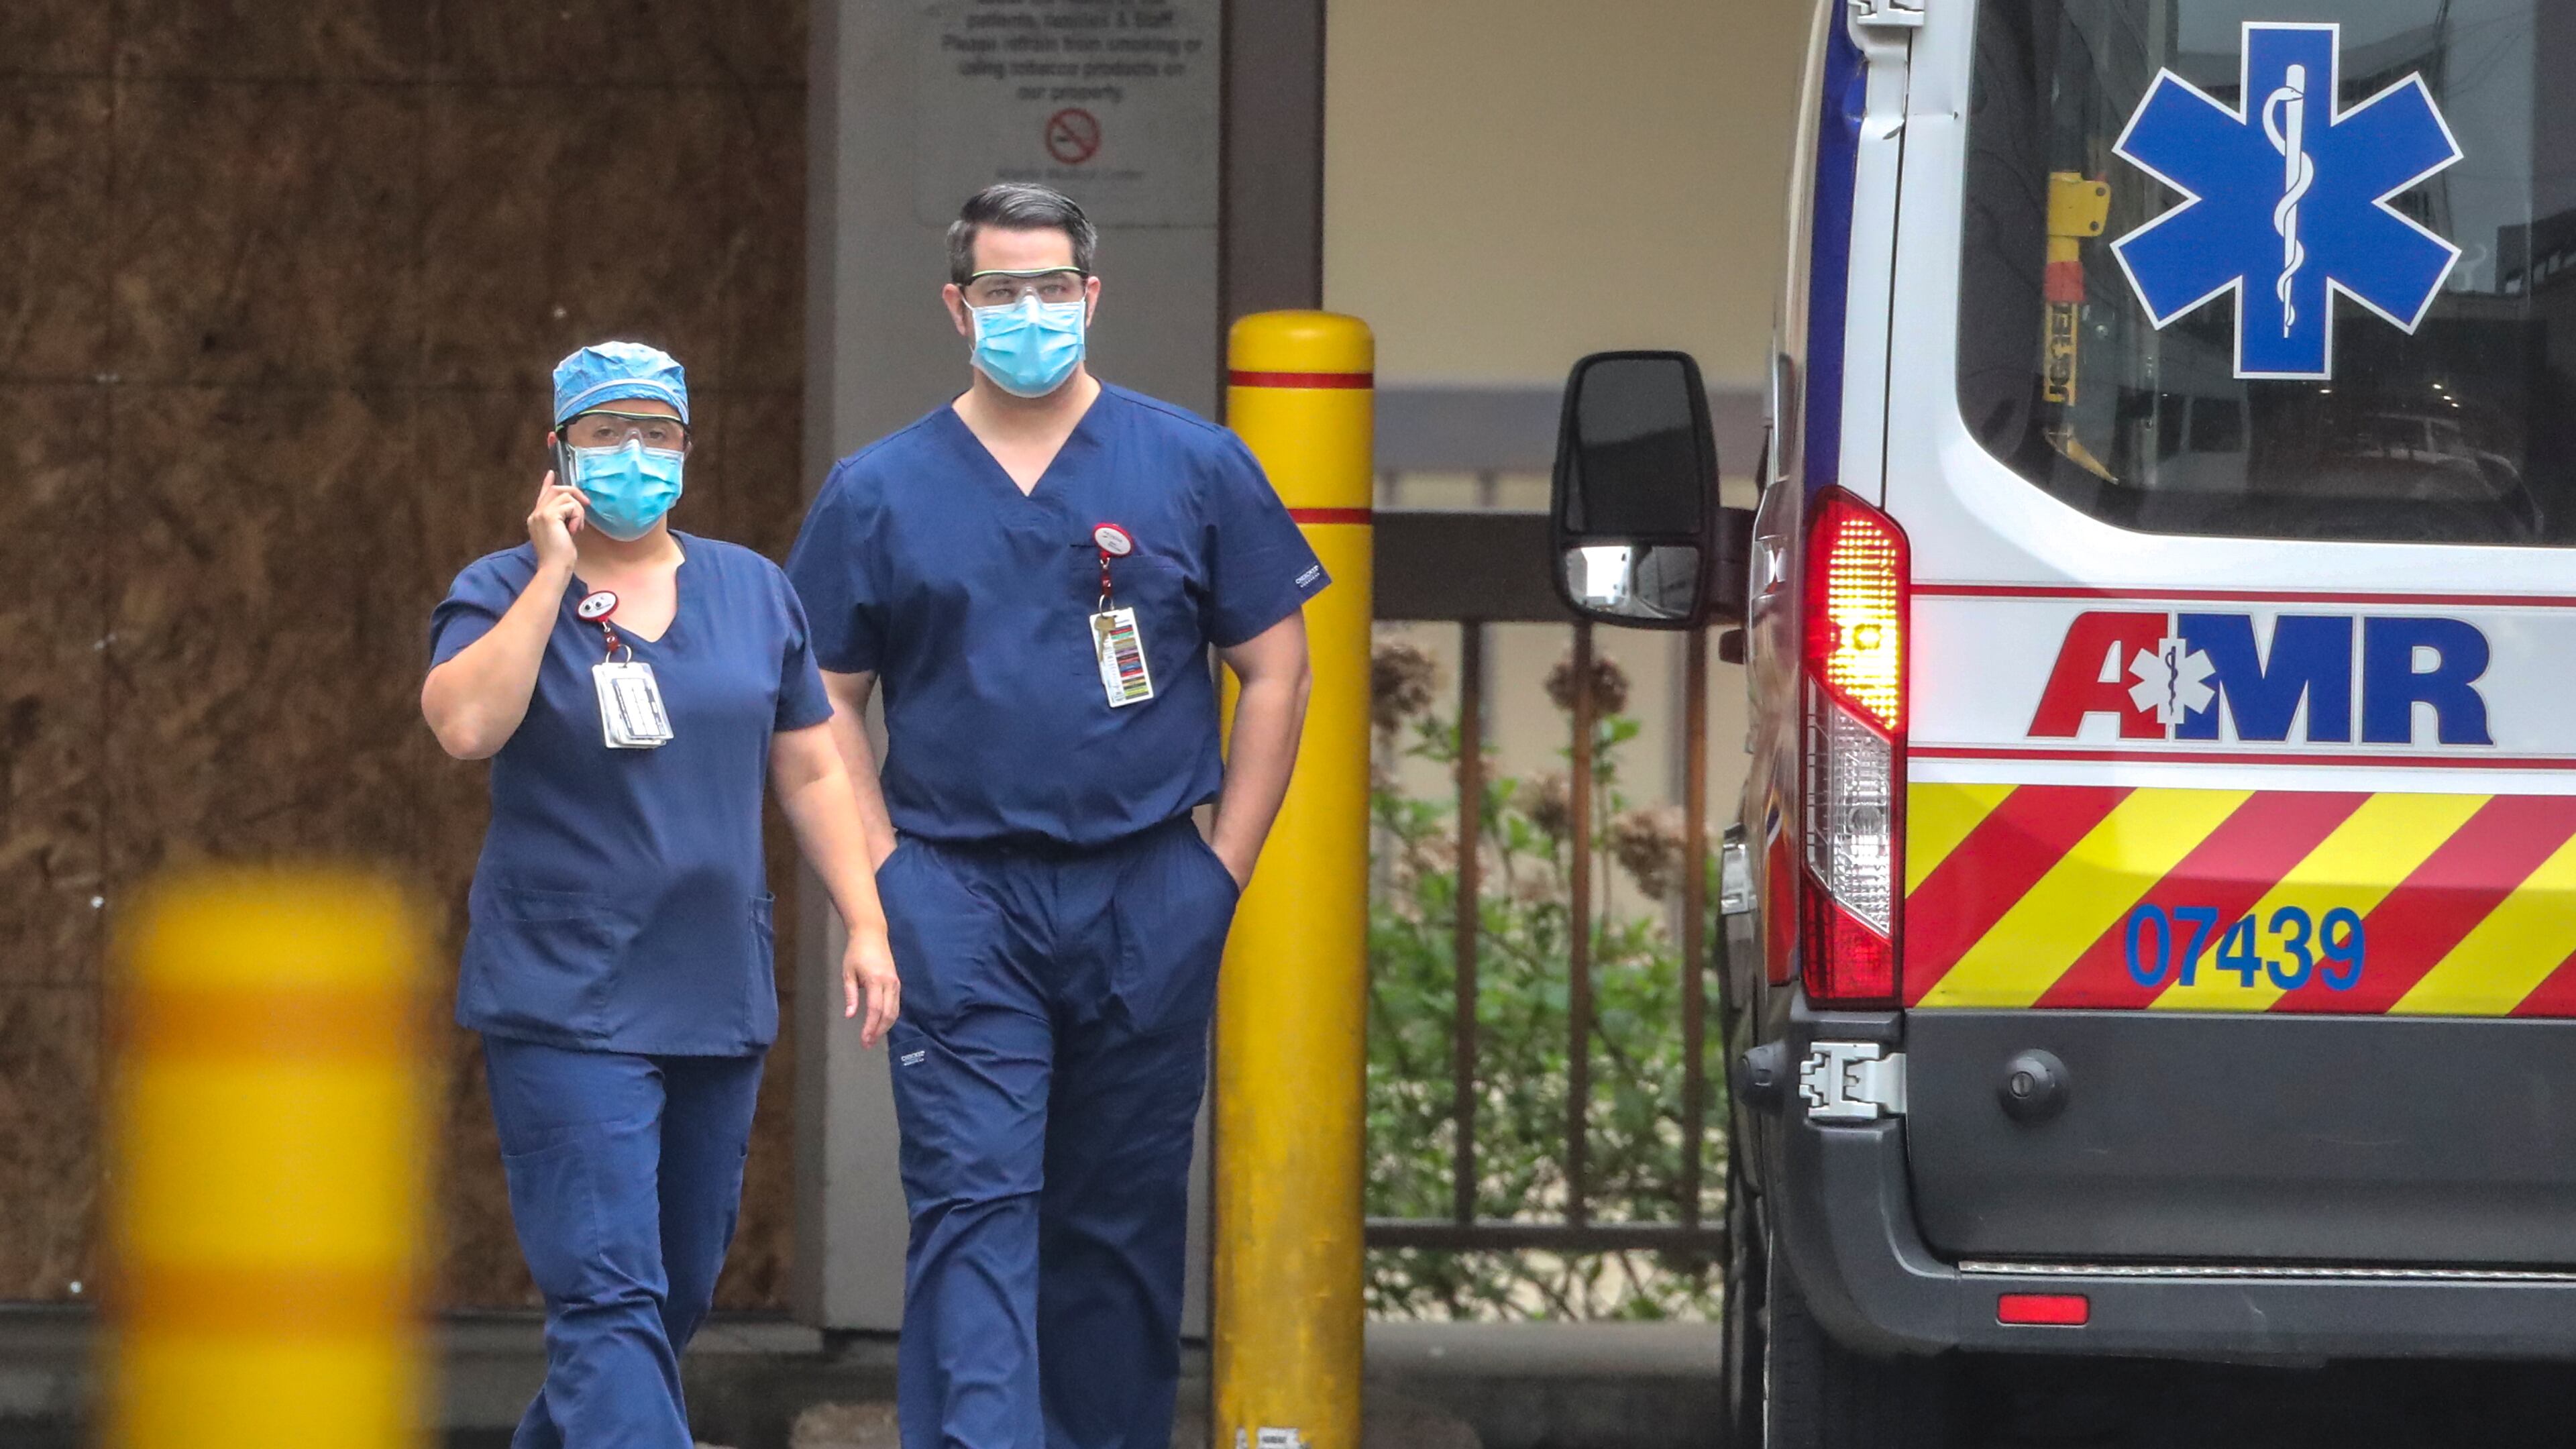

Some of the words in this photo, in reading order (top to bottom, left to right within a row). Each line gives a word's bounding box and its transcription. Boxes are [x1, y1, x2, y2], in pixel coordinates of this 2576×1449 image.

[1107, 38, 1180, 56] smoking
[2027, 610, 2495, 746] AMR
[2125, 904, 2365, 991] 07439
